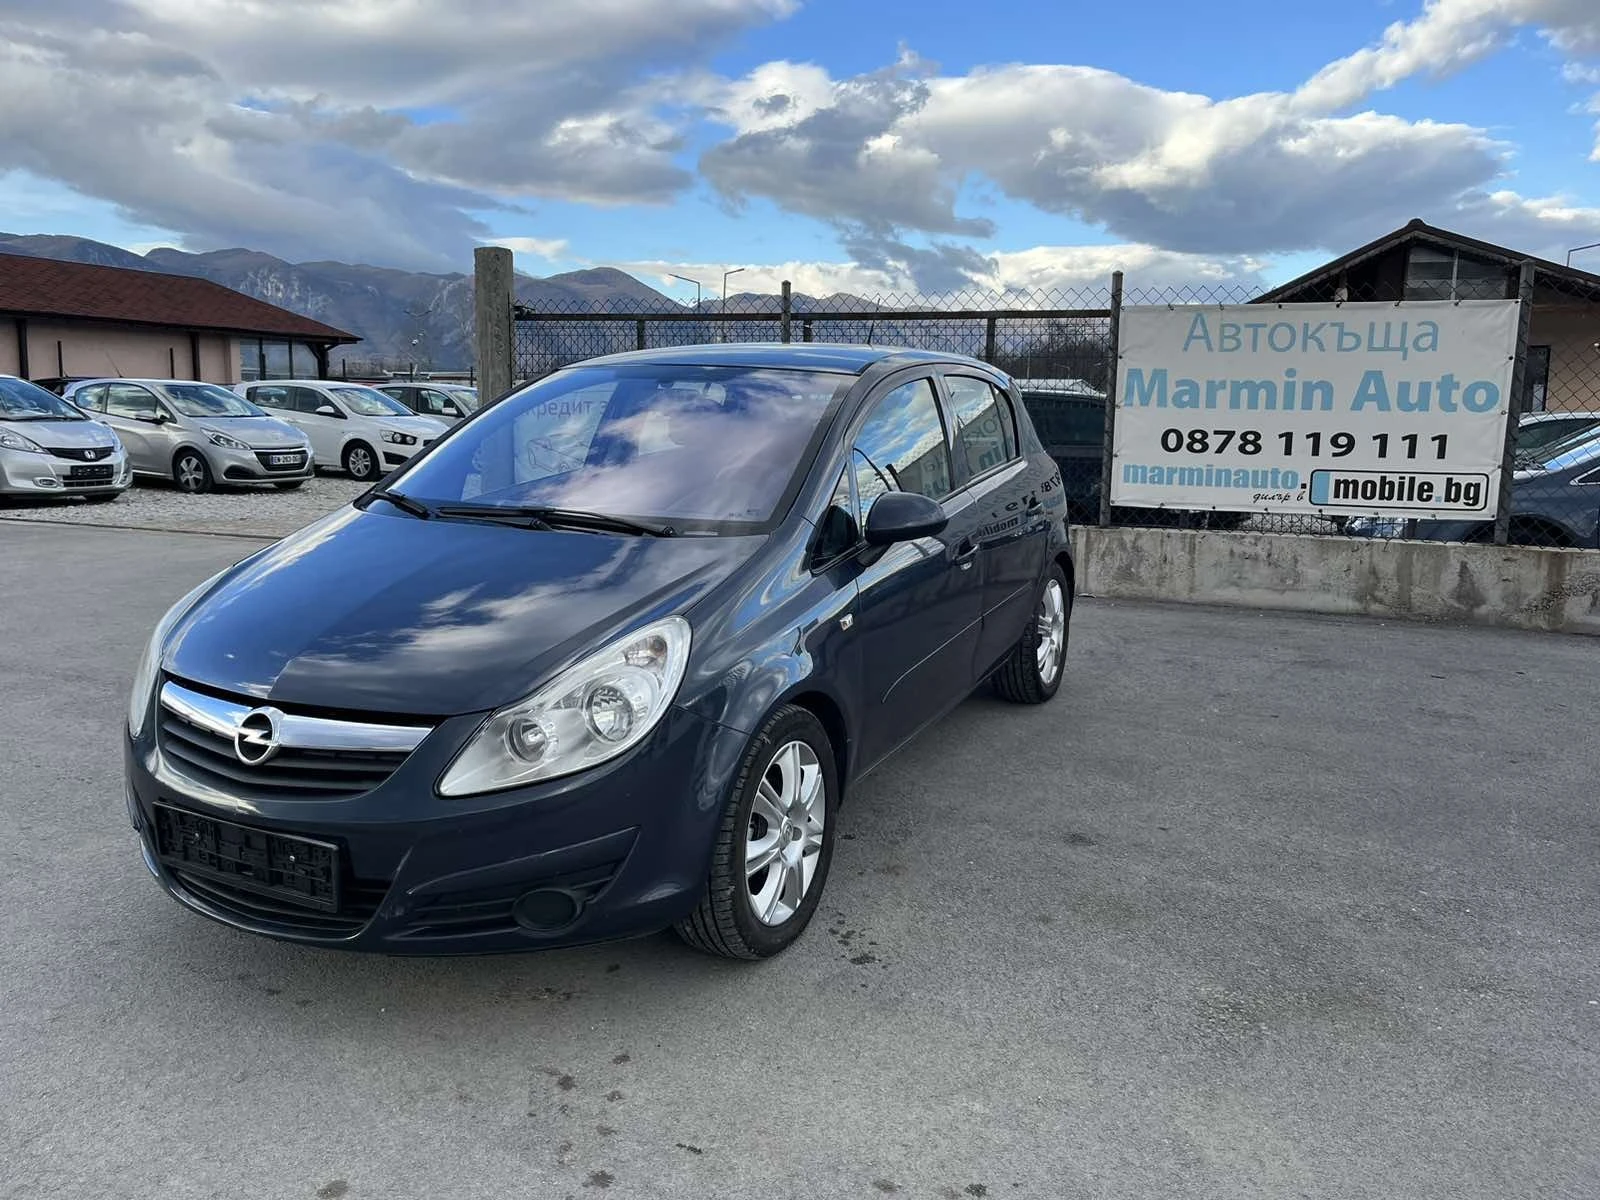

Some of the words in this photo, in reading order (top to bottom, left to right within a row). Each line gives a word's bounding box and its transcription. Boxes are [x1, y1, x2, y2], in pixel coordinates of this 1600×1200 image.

[1182, 312, 1440, 361] Автокъща
[1123, 367, 1334, 411] Marmin
[1350, 370, 1500, 413] Auto
[1161, 428, 1263, 455] 0878
[1278, 431, 1356, 458] 119
[1371, 433, 1448, 459] 111
[1333, 475, 1481, 506] mobile.bg
